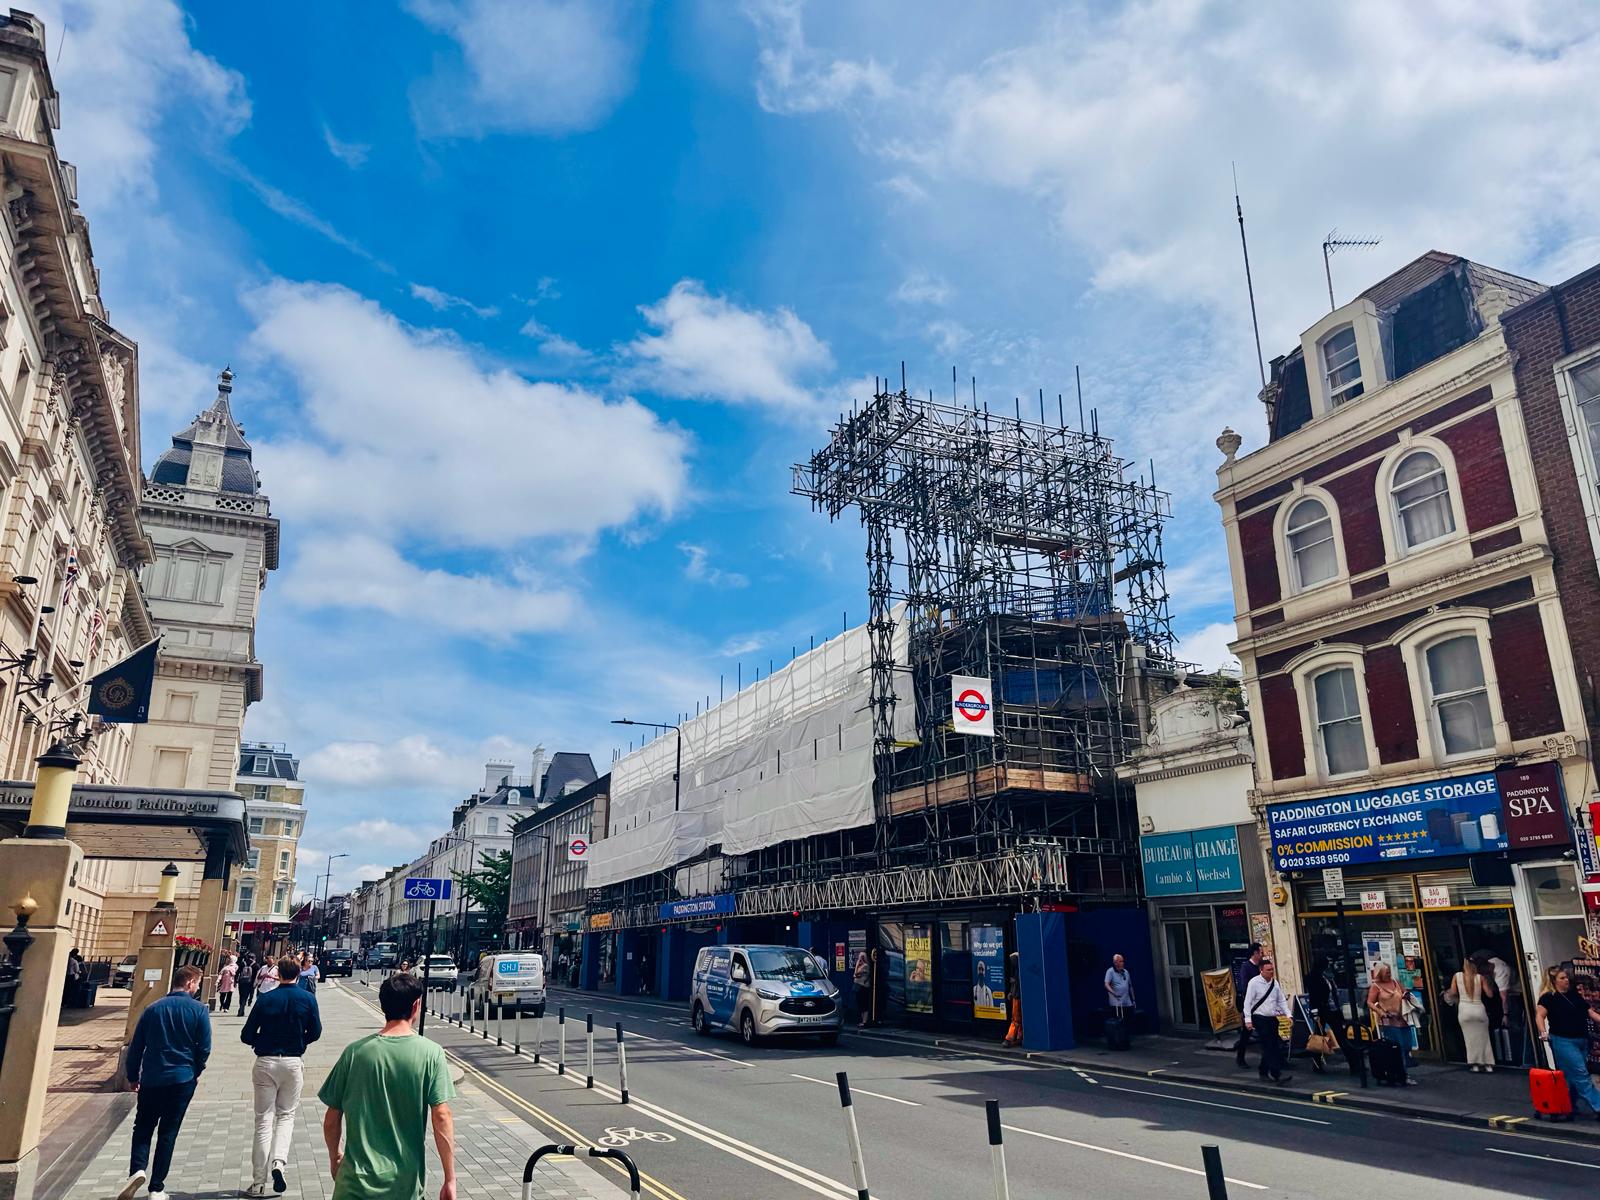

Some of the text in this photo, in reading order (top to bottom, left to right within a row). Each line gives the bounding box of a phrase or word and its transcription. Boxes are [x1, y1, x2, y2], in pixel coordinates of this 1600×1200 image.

[1506, 786, 1549, 797] PADDINGTON
[75, 796, 131, 809] London
[136, 798, 218, 815] Paddington
[1272, 779, 1496, 823] PADDINGTON LUGGAGE STORAGE
[1509, 796, 1555, 817] SPA
[1274, 811, 1423, 839] SAFARI CURRENCY EXCHANGE
[1144, 838, 1238, 864] BUREAU DE CHANGE
[1277, 834, 1373, 856] 0% COMMISSION
[1288, 853, 1350, 867] 020 3538 9500
[1155, 866, 1231, 885] Cambio & Wechsel
[1367, 893, 1377, 901] BAG
[1428, 888, 1440, 896] BAG
[673, 901, 716, 914] PADDINGTON STATION
[1438, 897, 1448, 905] OFF
[501, 963, 517, 972] SHJ
